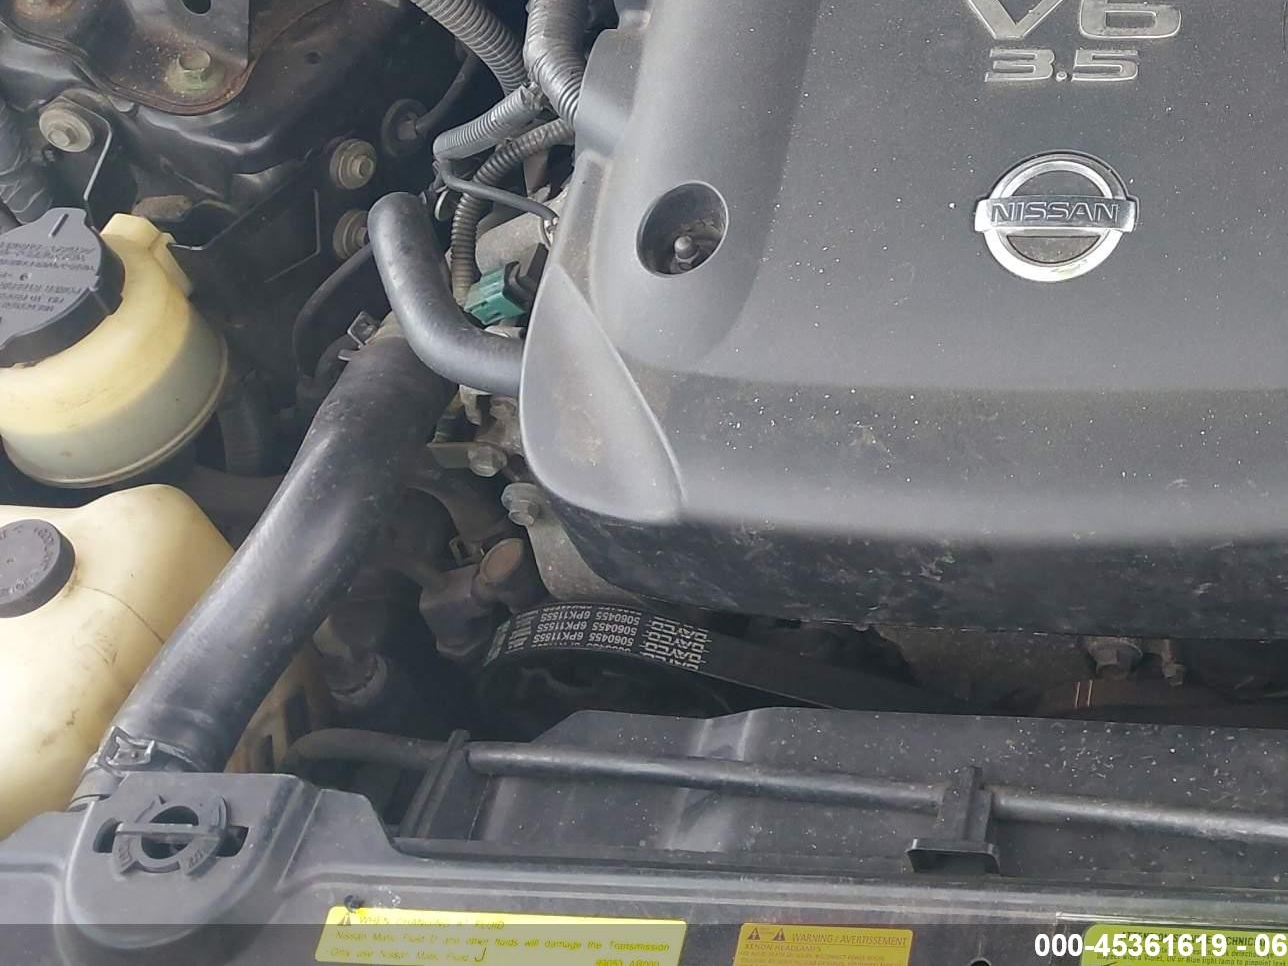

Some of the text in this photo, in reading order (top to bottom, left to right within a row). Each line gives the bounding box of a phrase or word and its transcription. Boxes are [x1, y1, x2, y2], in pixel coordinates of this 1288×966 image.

[984, 48, 1139, 83] 3.5
[991, 201, 1119, 223] NISSAN
[540, 610, 592, 623] 6PK1155S
[596, 611, 642, 626] 5060455
[536, 621, 588, 633] 6PK1155S
[592, 622, 638, 636] 5060455
[532, 631, 584, 644] 6PK1155S
[589, 632, 635, 647] 5060455
[544, 939, 582, 951] damage
[587, 940, 603, 951] the
[610, 940, 670, 952] Transmission
[791, 933, 833, 944] WARNING
[840, 935, 908, 946] AVERTISSEMENT
